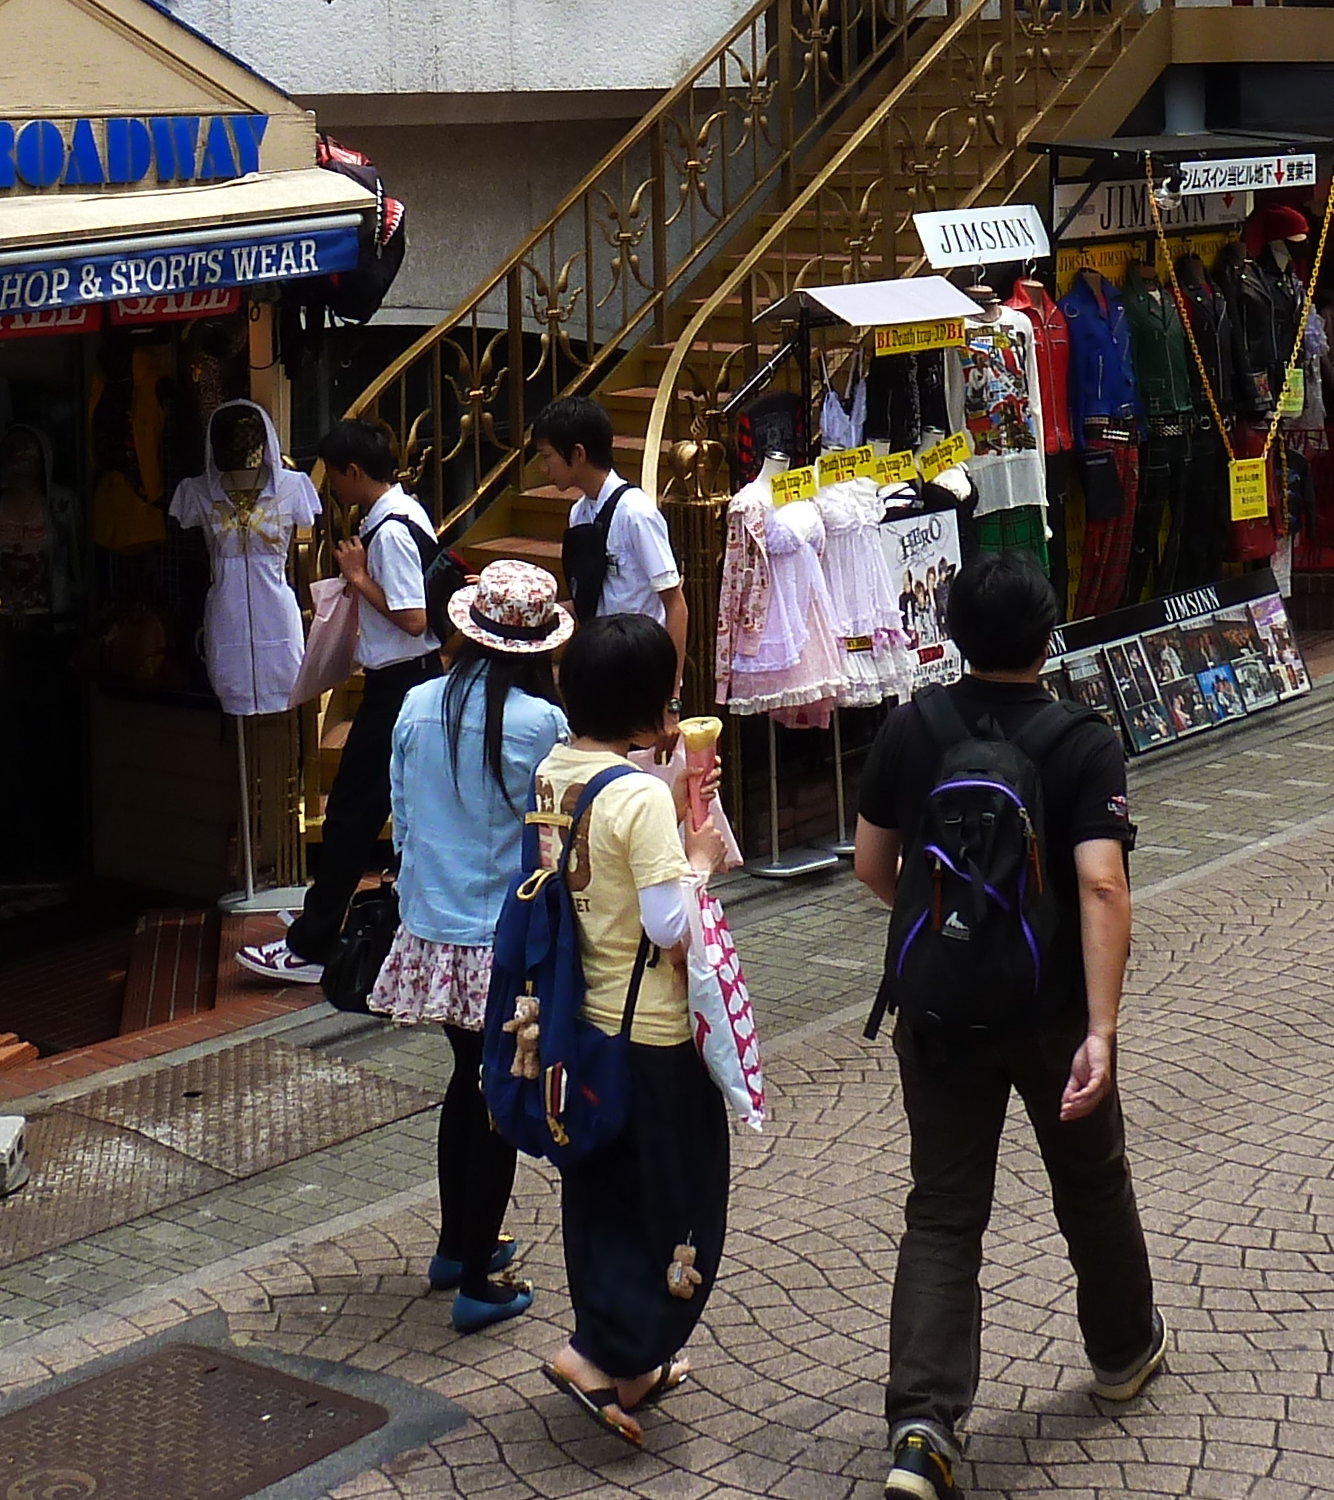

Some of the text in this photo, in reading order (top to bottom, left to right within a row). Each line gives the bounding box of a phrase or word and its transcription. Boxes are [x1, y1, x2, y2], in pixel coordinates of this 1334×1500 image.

[1100, 184, 1207, 231] JIMINN
[939, 218, 1036, 254] JIMSINN
[1, 269, 70, 311] HOP
[79, 264, 104, 300] &
[111, 248, 224, 296] SPORTS
[232, 238, 318, 282] WEAR
[1162, 586, 1220, 623] JIMSINN
